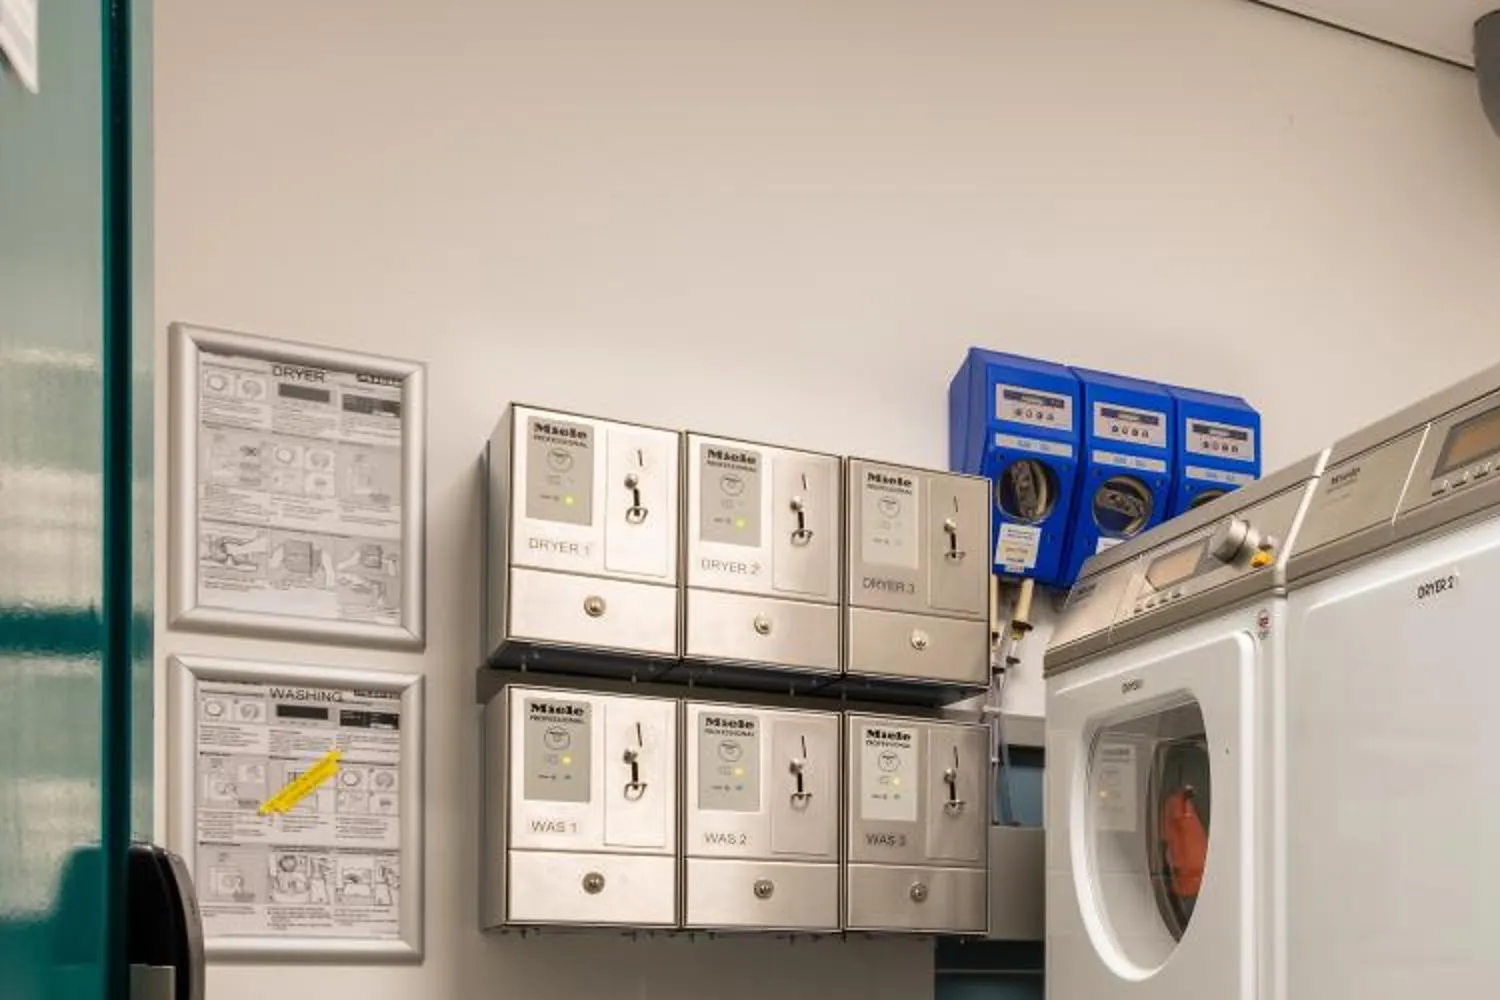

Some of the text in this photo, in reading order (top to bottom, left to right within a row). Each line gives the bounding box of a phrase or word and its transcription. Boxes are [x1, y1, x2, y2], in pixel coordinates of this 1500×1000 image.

[272, 365, 326, 384] DRYER
[534, 422, 587, 439] Miele
[707, 449, 756, 464] Miele
[867, 472, 912, 487] Miele
[529, 538, 579, 555] DRYER
[701, 558, 761, 576] DRYER 2
[863, 577, 905, 593] DRYER
[1418, 579, 1446, 599] DRYER
[269, 687, 343, 703] WASHING
[531, 703, 585, 716] Miele
[705, 717, 754, 729] Miele
[866, 729, 911, 741] Miele
[531, 819, 577, 833] WAS 1
[704, 832, 748, 846] WAS 2
[865, 833, 896, 847] WAS
